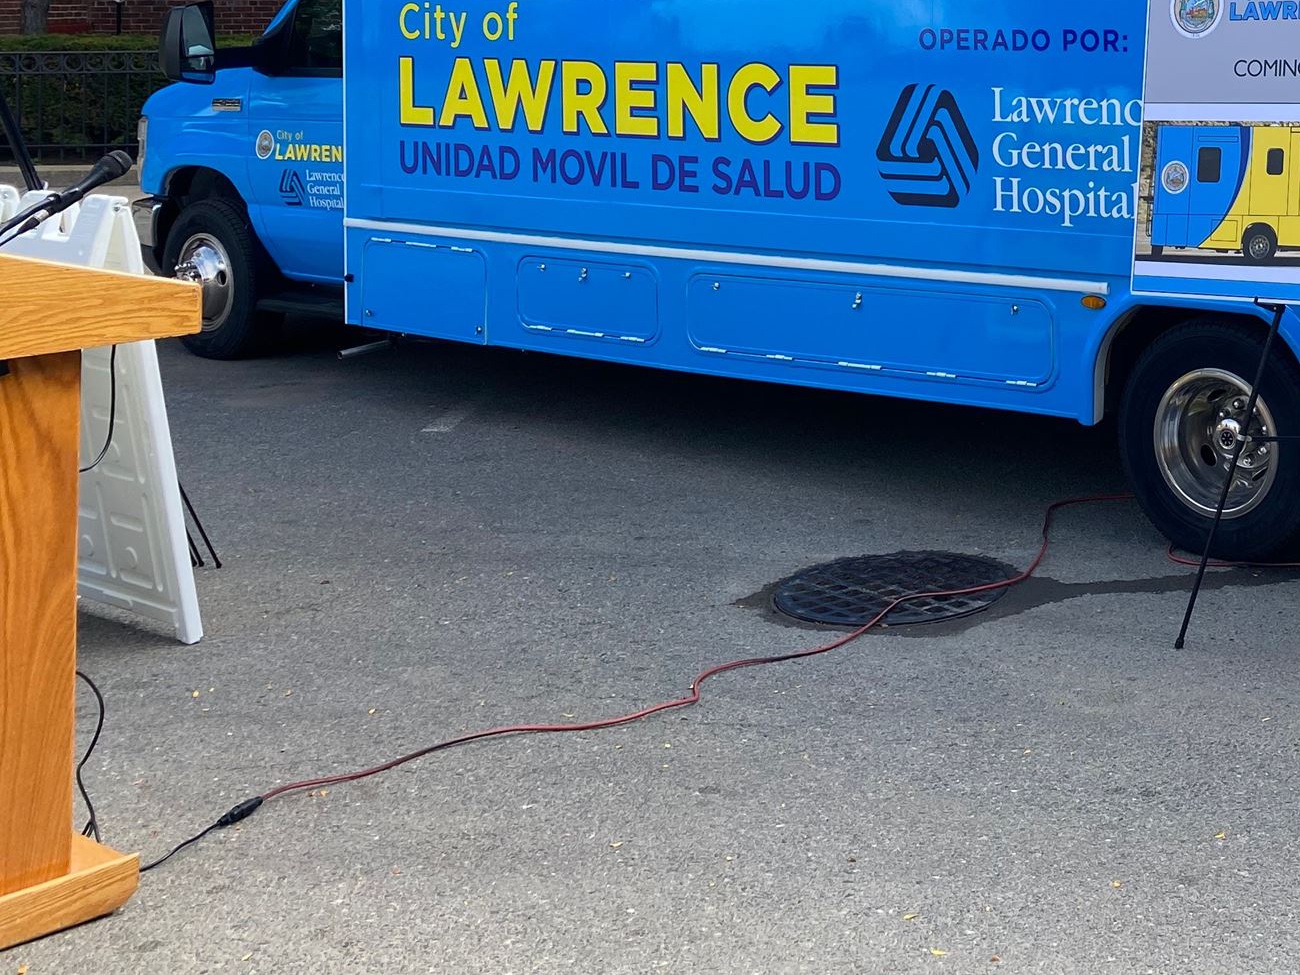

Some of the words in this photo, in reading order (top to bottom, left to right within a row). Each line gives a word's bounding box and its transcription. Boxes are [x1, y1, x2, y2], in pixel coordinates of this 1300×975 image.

[399, 1, 467, 49] City
[482, 1, 519, 41] of
[918, 27, 1051, 52] OPERADO
[1062, 28, 1129, 53] POR:
[398, 56, 841, 148] LAWRENCE
[991, 87, 1143, 127] Lawrenc
[276, 129, 292, 141] City
[295, 129, 304, 140] of
[274, 143, 343, 163] LAWREN
[991, 131, 1133, 173] General
[400, 140, 521, 181] UNIDAD
[532, 147, 640, 189] MOVIL
[651, 153, 700, 193] DE
[711, 156, 842, 201] SALUD
[307, 182, 341, 195] General
[309, 196, 344, 210] Hospital
